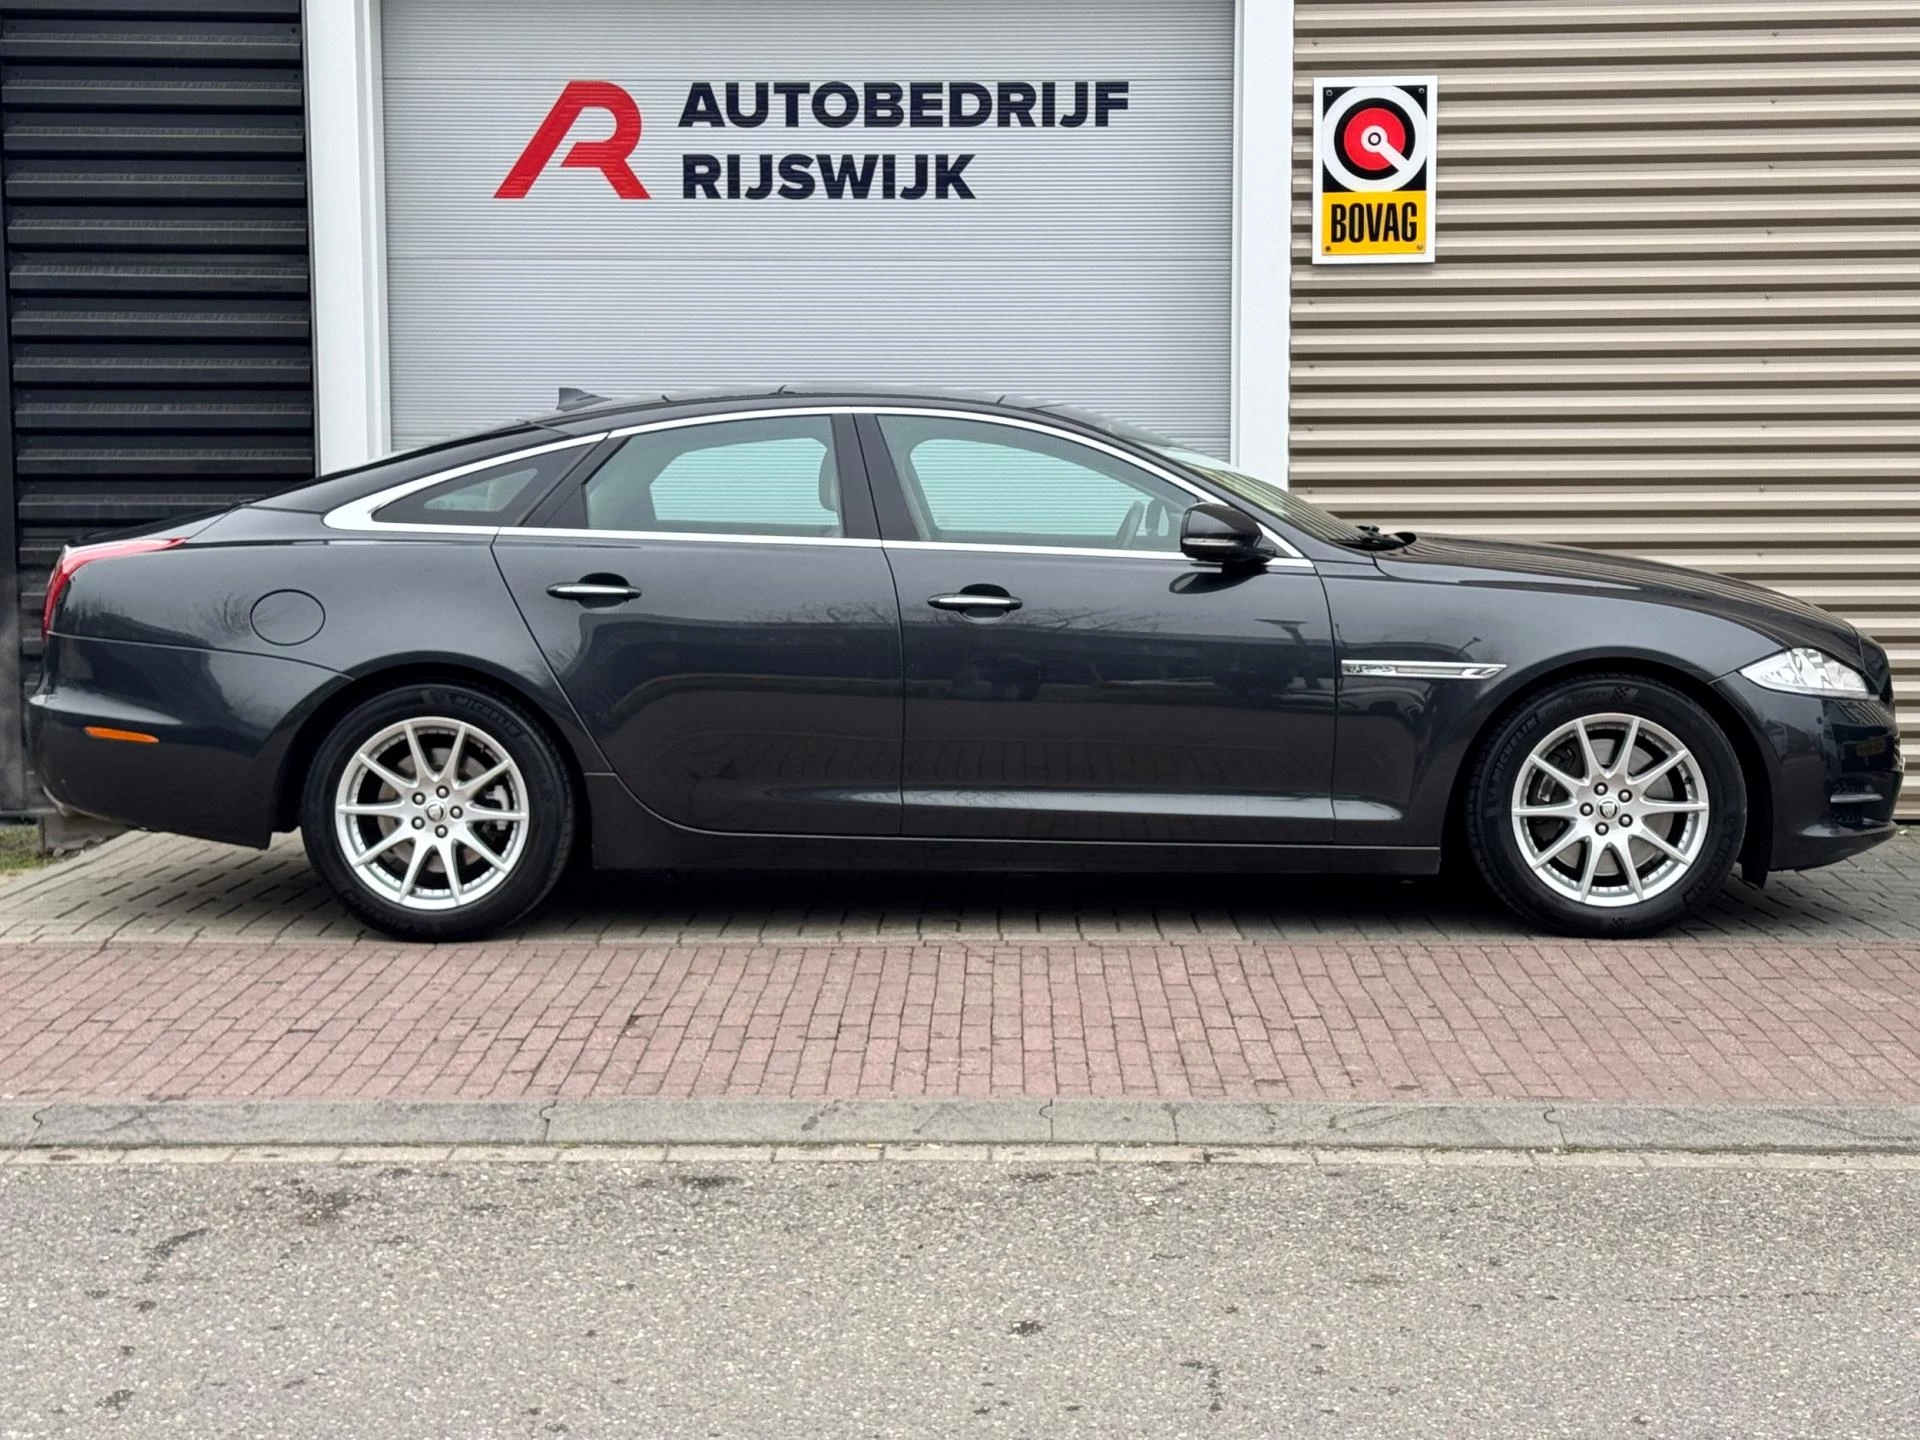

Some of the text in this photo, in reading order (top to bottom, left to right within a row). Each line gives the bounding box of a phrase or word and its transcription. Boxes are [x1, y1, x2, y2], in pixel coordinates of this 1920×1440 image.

[679, 82, 1128, 128] AUTOBEDRIJF
[683, 154, 975, 199] RIJSWIJK
[1331, 202, 1416, 242] BOVAG
